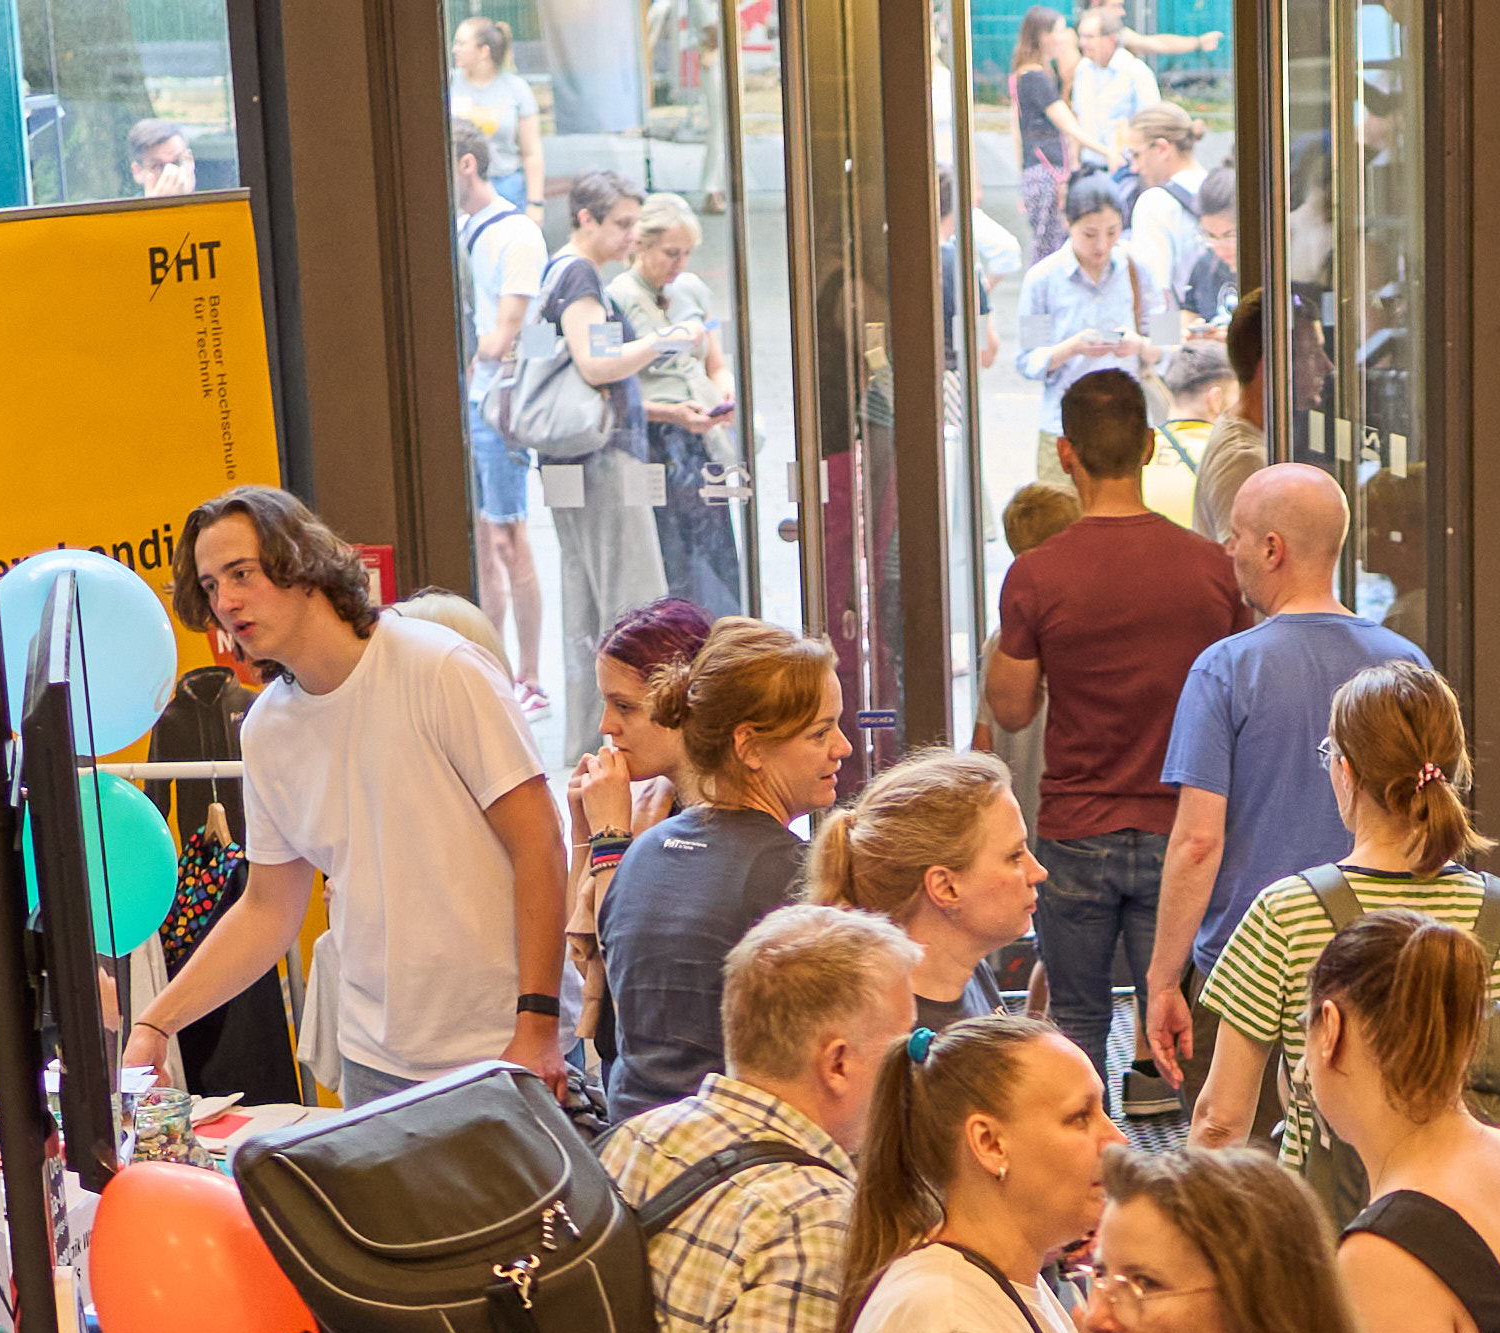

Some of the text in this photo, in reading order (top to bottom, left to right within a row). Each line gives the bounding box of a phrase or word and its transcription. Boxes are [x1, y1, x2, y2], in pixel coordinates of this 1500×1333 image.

[149, 240, 222, 285] BHT
[194, 296, 212, 399] für Technik
[208, 295, 237, 482] Berliner Hochschule
